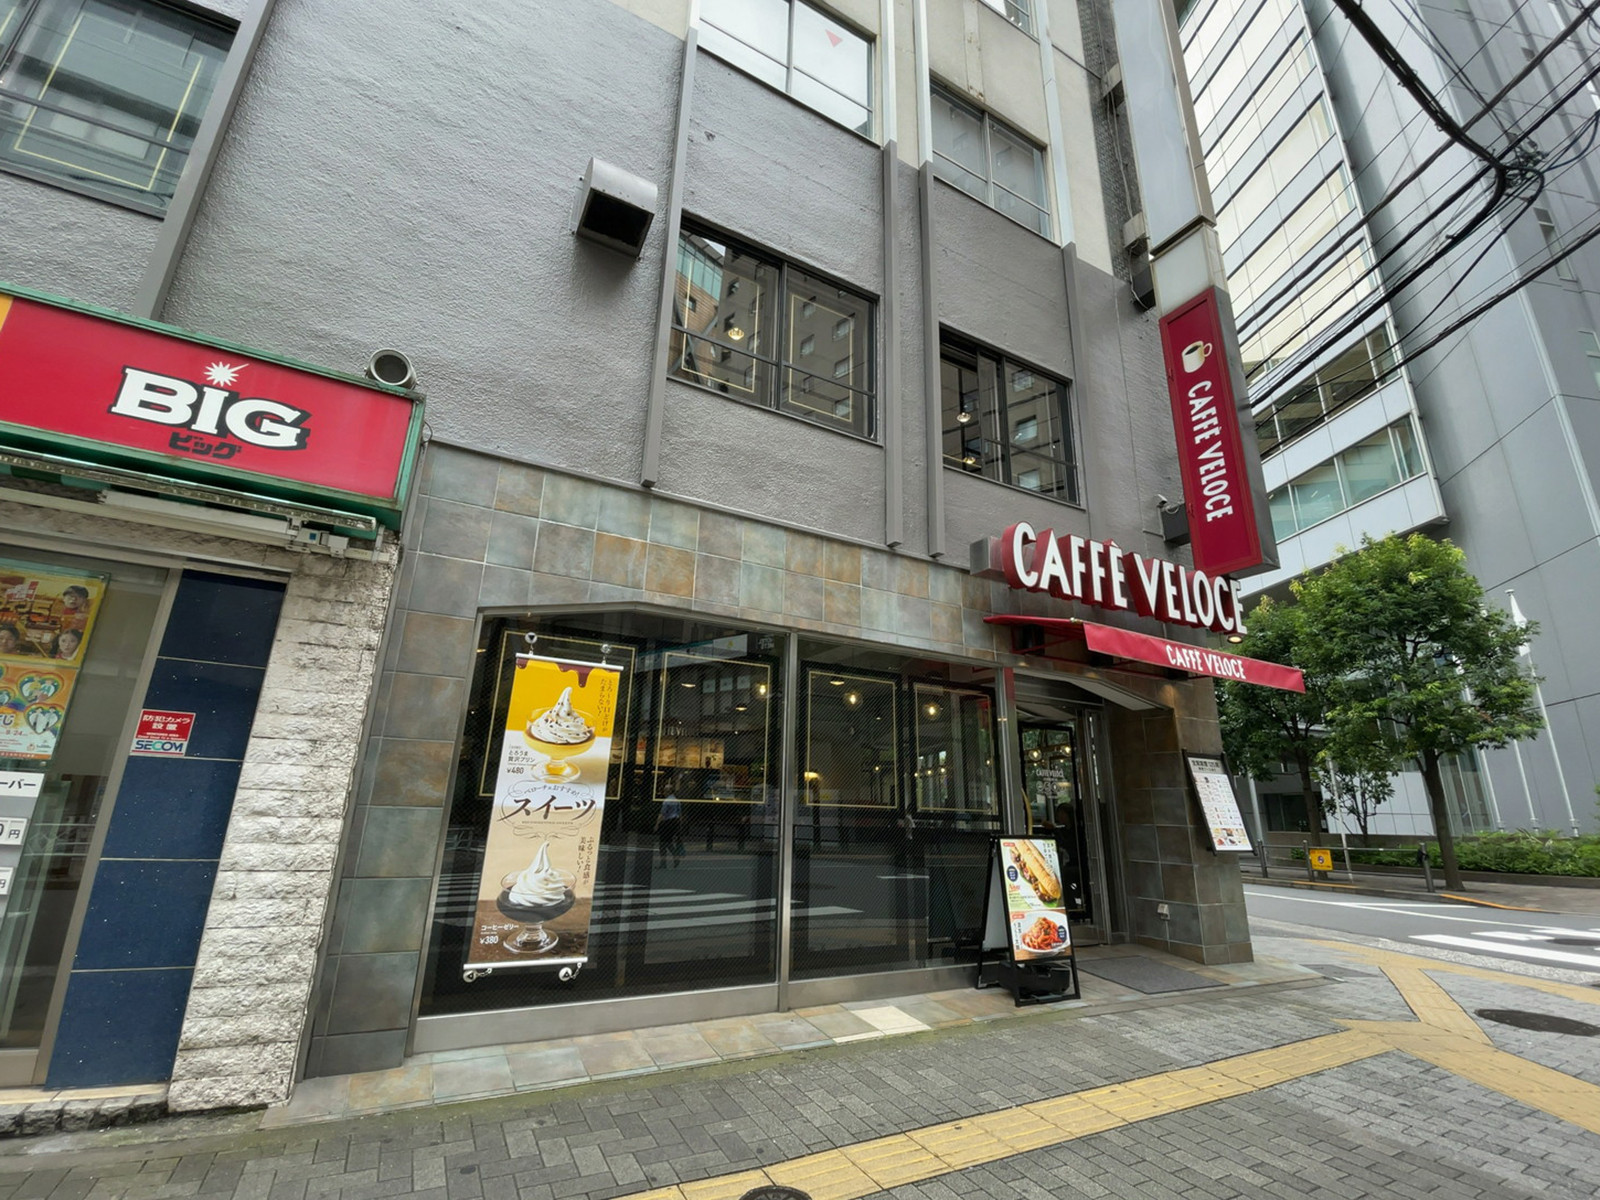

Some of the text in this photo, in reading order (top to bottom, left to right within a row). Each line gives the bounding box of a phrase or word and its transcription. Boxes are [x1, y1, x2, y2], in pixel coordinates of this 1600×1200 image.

[109, 366, 307, 449] BIG
[168, 431, 242, 460] ビッグ
[1197, 440, 1234, 522] VELOCE
[1133, 552, 1248, 635] VELOCE
[1201, 652, 1246, 680] VELOCE
[142, 714, 190, 725] 防犯カメラ
[152, 722, 178, 731] 設置
[135, 740, 184, 753] SECOM
[497, 795, 596, 821] スイーツ
[479, 935, 499, 945] ¥380
